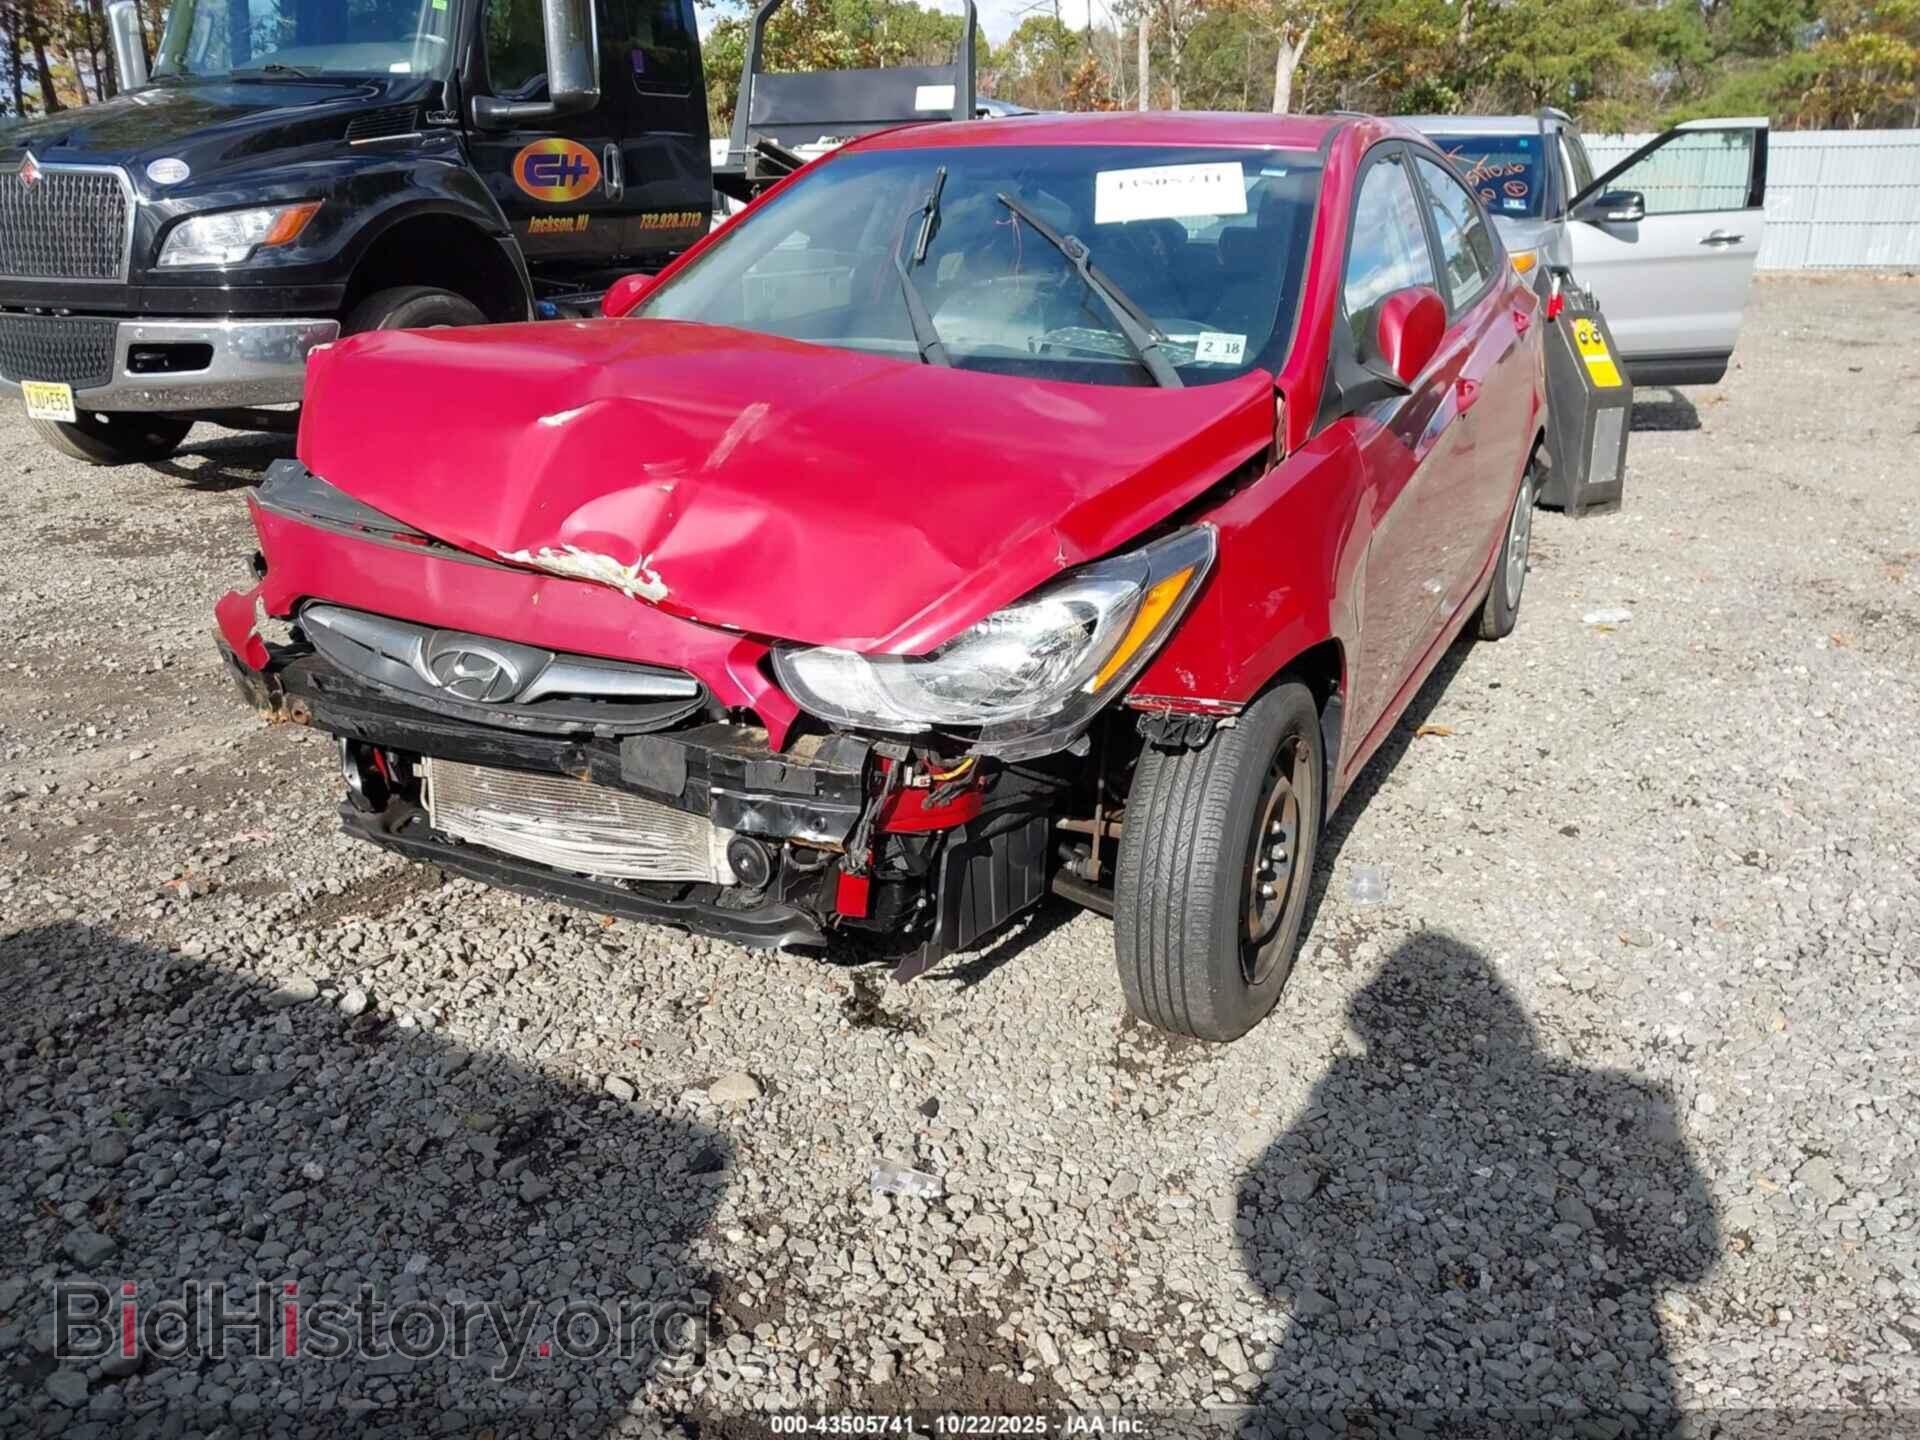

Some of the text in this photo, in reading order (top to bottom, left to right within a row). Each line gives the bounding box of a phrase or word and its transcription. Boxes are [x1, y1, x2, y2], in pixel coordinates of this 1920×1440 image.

[528, 215, 574, 233] Jackson,
[1203, 341, 1241, 354] 2 18
